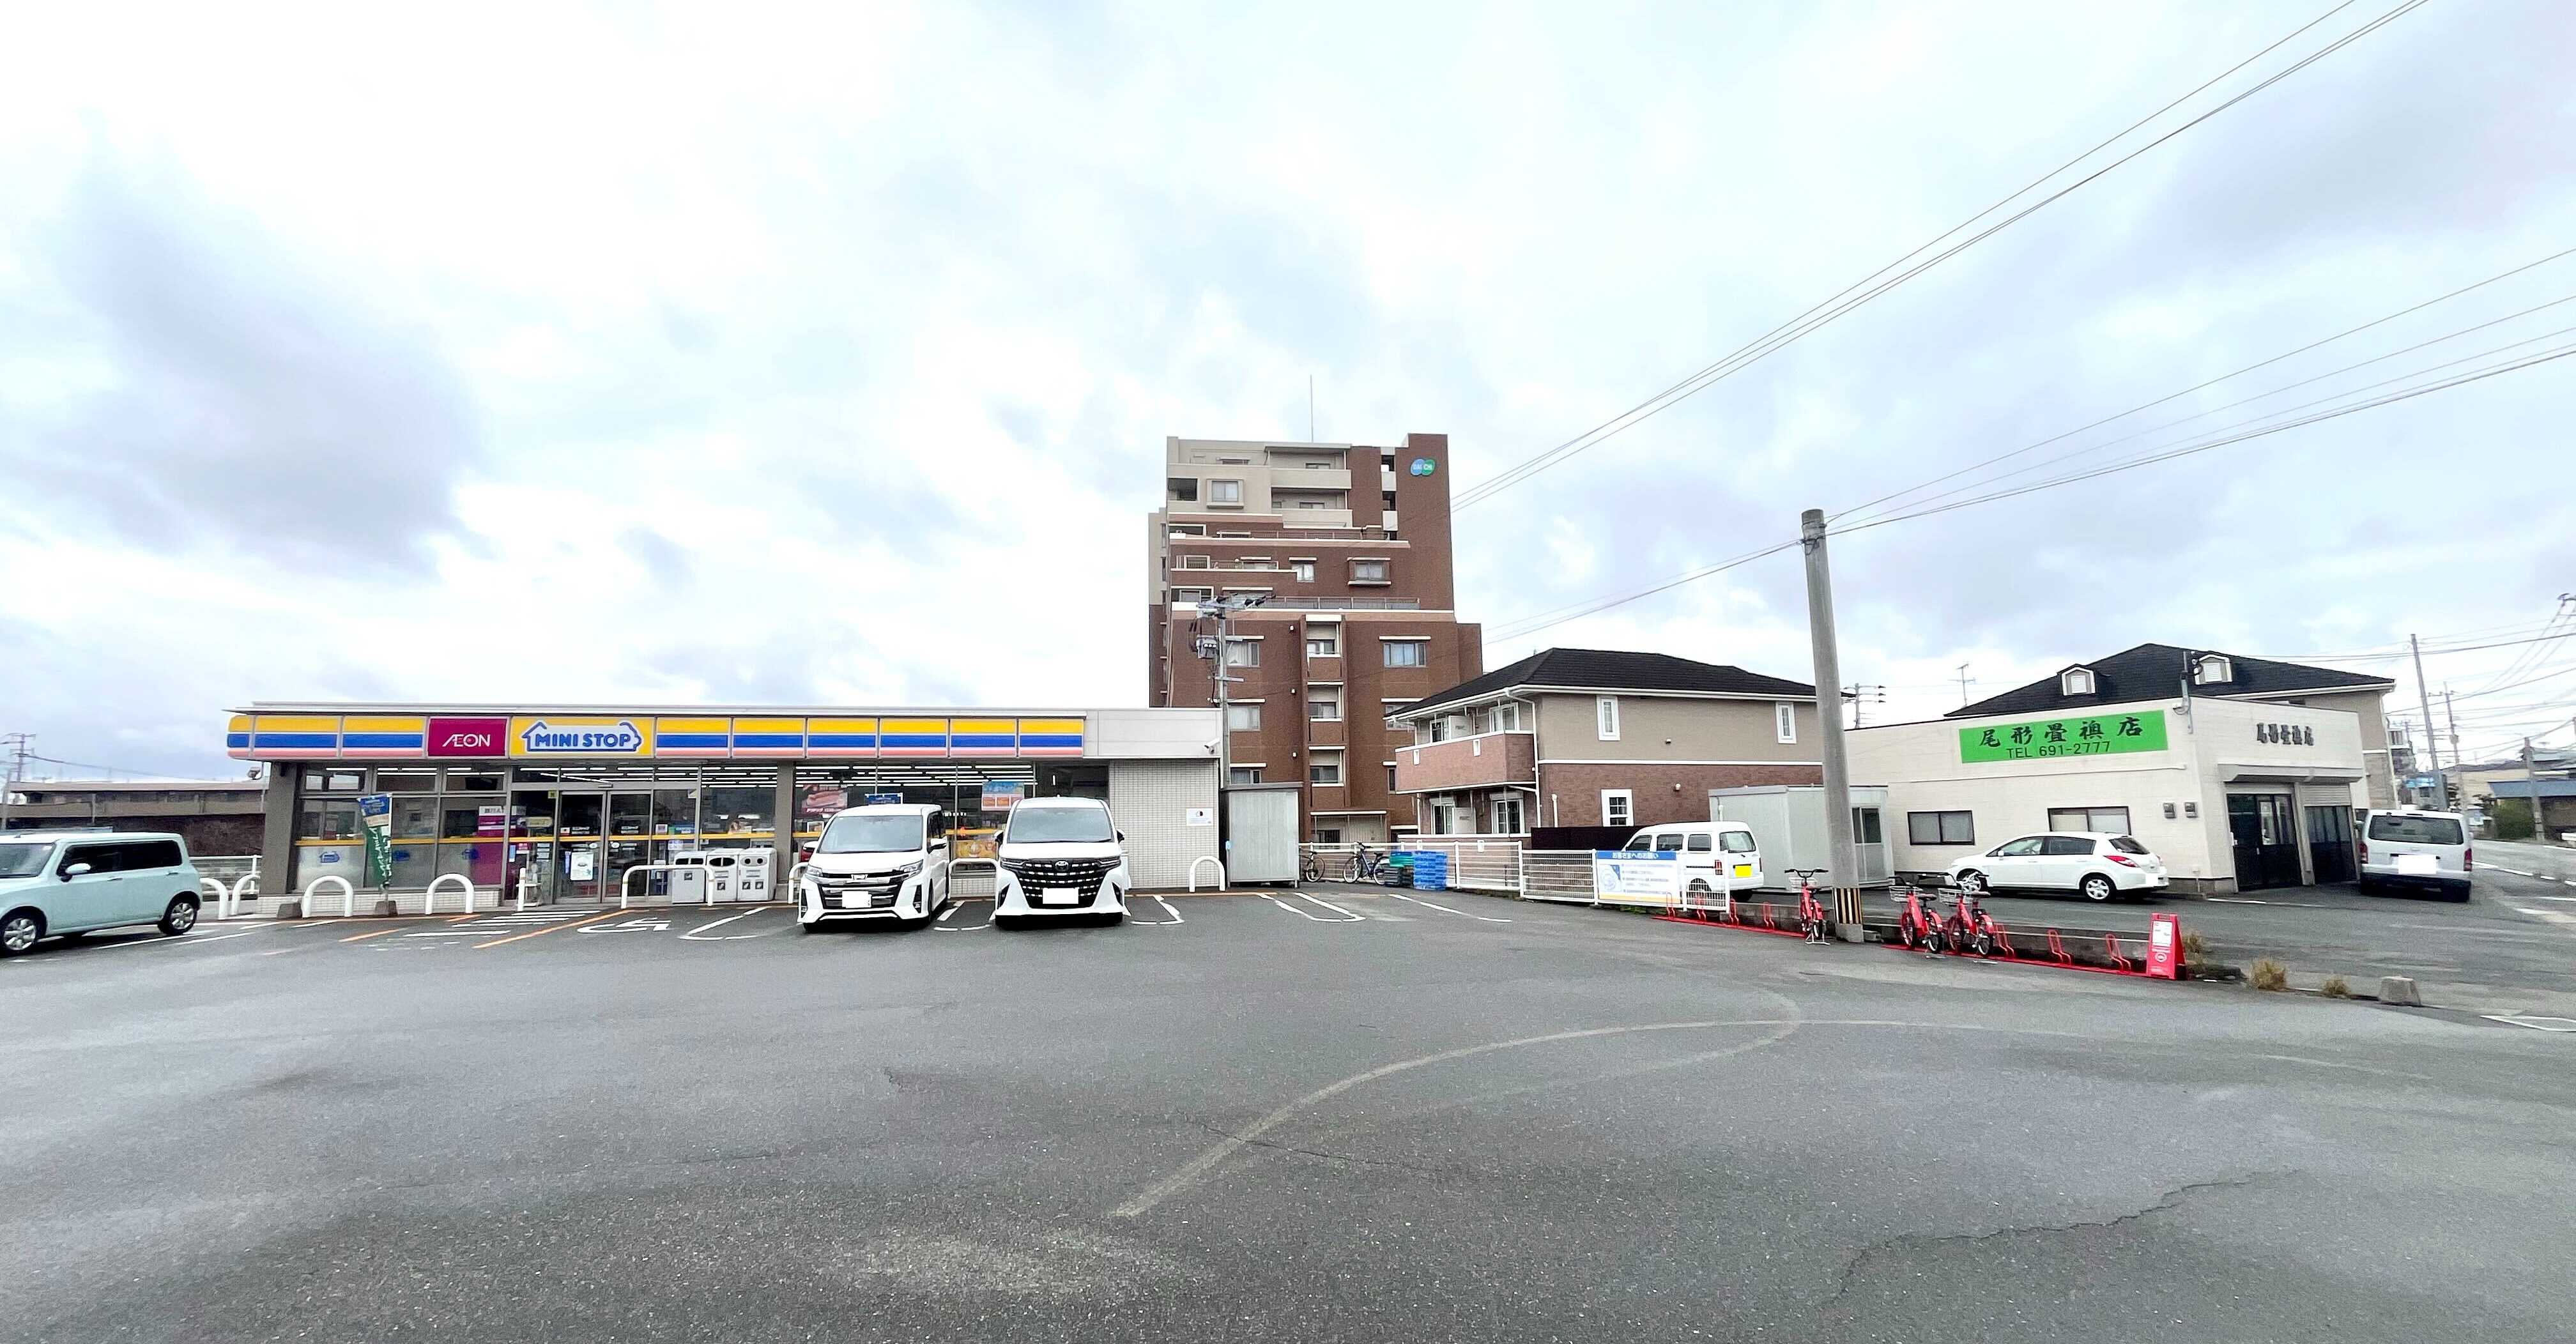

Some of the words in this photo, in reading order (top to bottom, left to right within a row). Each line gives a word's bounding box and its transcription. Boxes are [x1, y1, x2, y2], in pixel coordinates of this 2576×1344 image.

[535, 733, 578, 747] MINI
[582, 733, 631, 747] STOP
[2006, 747, 2033, 759] TEL
[2039, 741, 2110, 756] 691-2777
